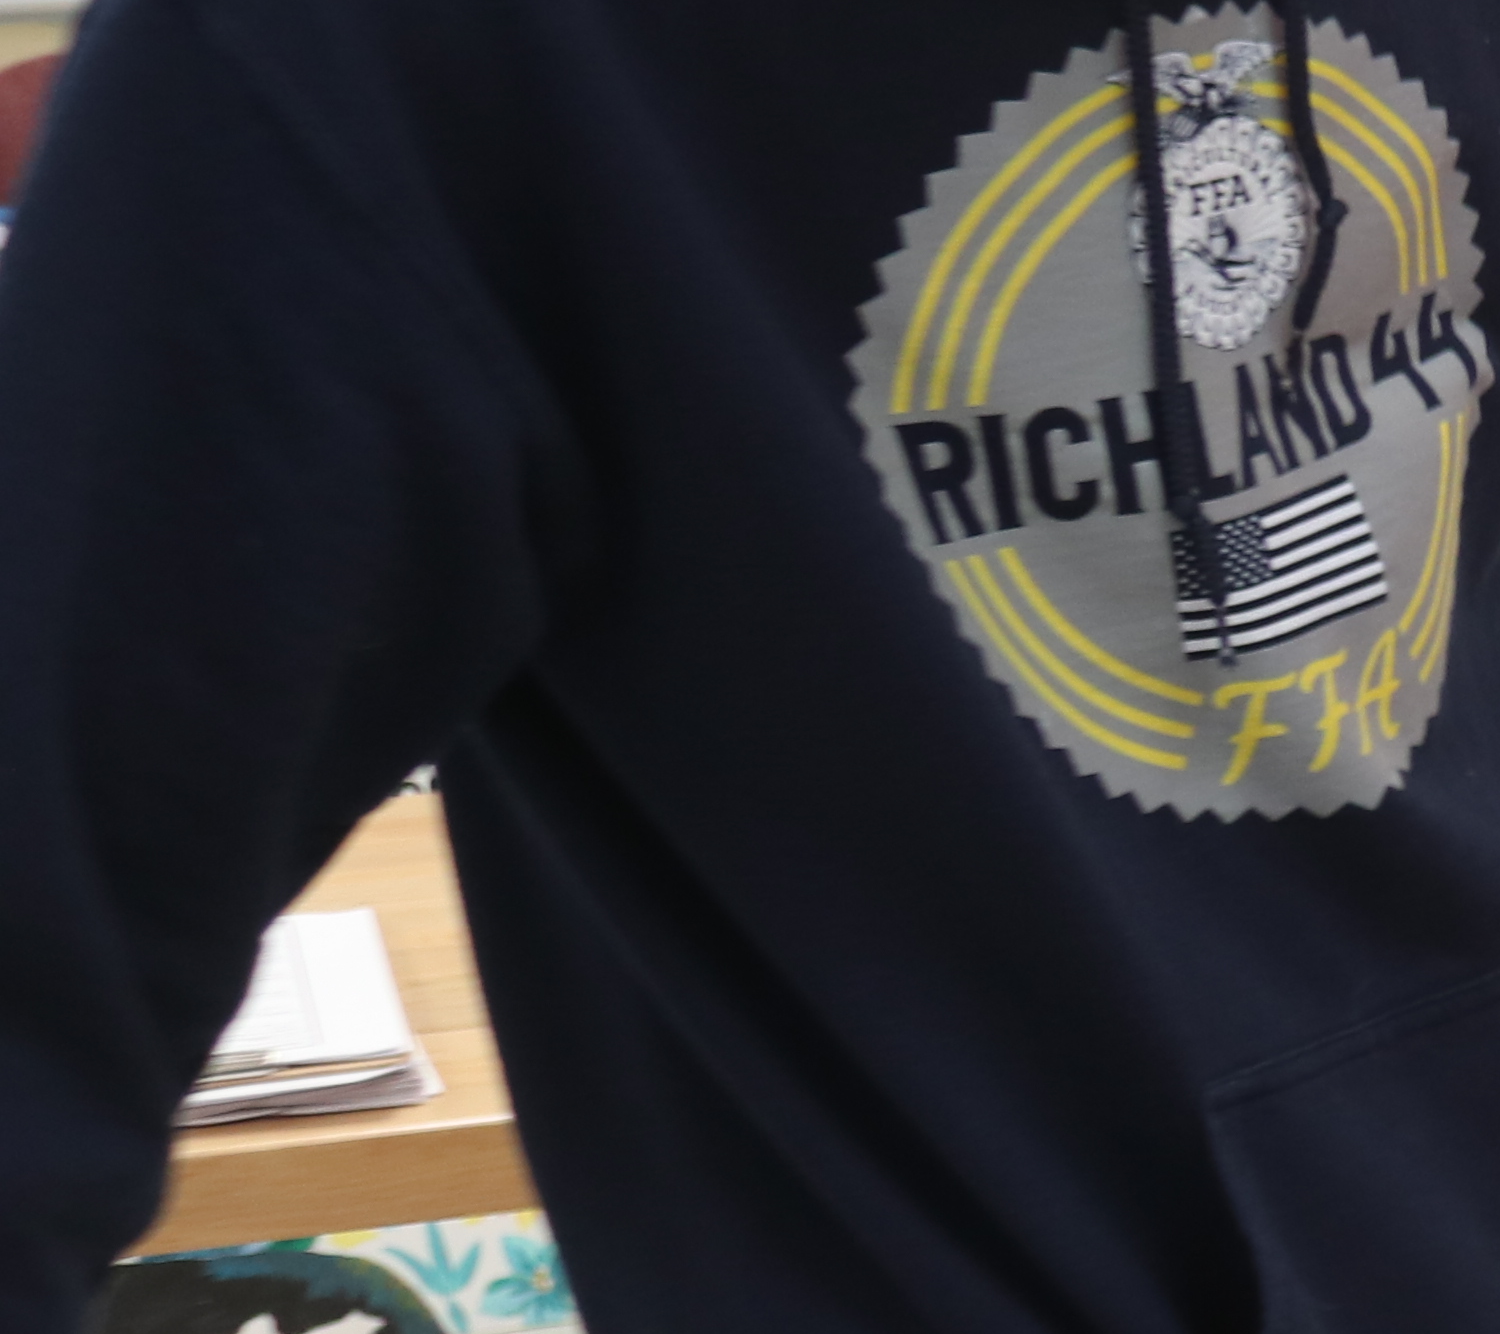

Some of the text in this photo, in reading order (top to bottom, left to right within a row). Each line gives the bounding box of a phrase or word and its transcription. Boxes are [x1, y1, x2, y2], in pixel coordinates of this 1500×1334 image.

[1190, 173, 1252, 216] FFA
[892, 291, 1480, 547] RICHLAND 44
[1210, 630, 1406, 786] FFA
